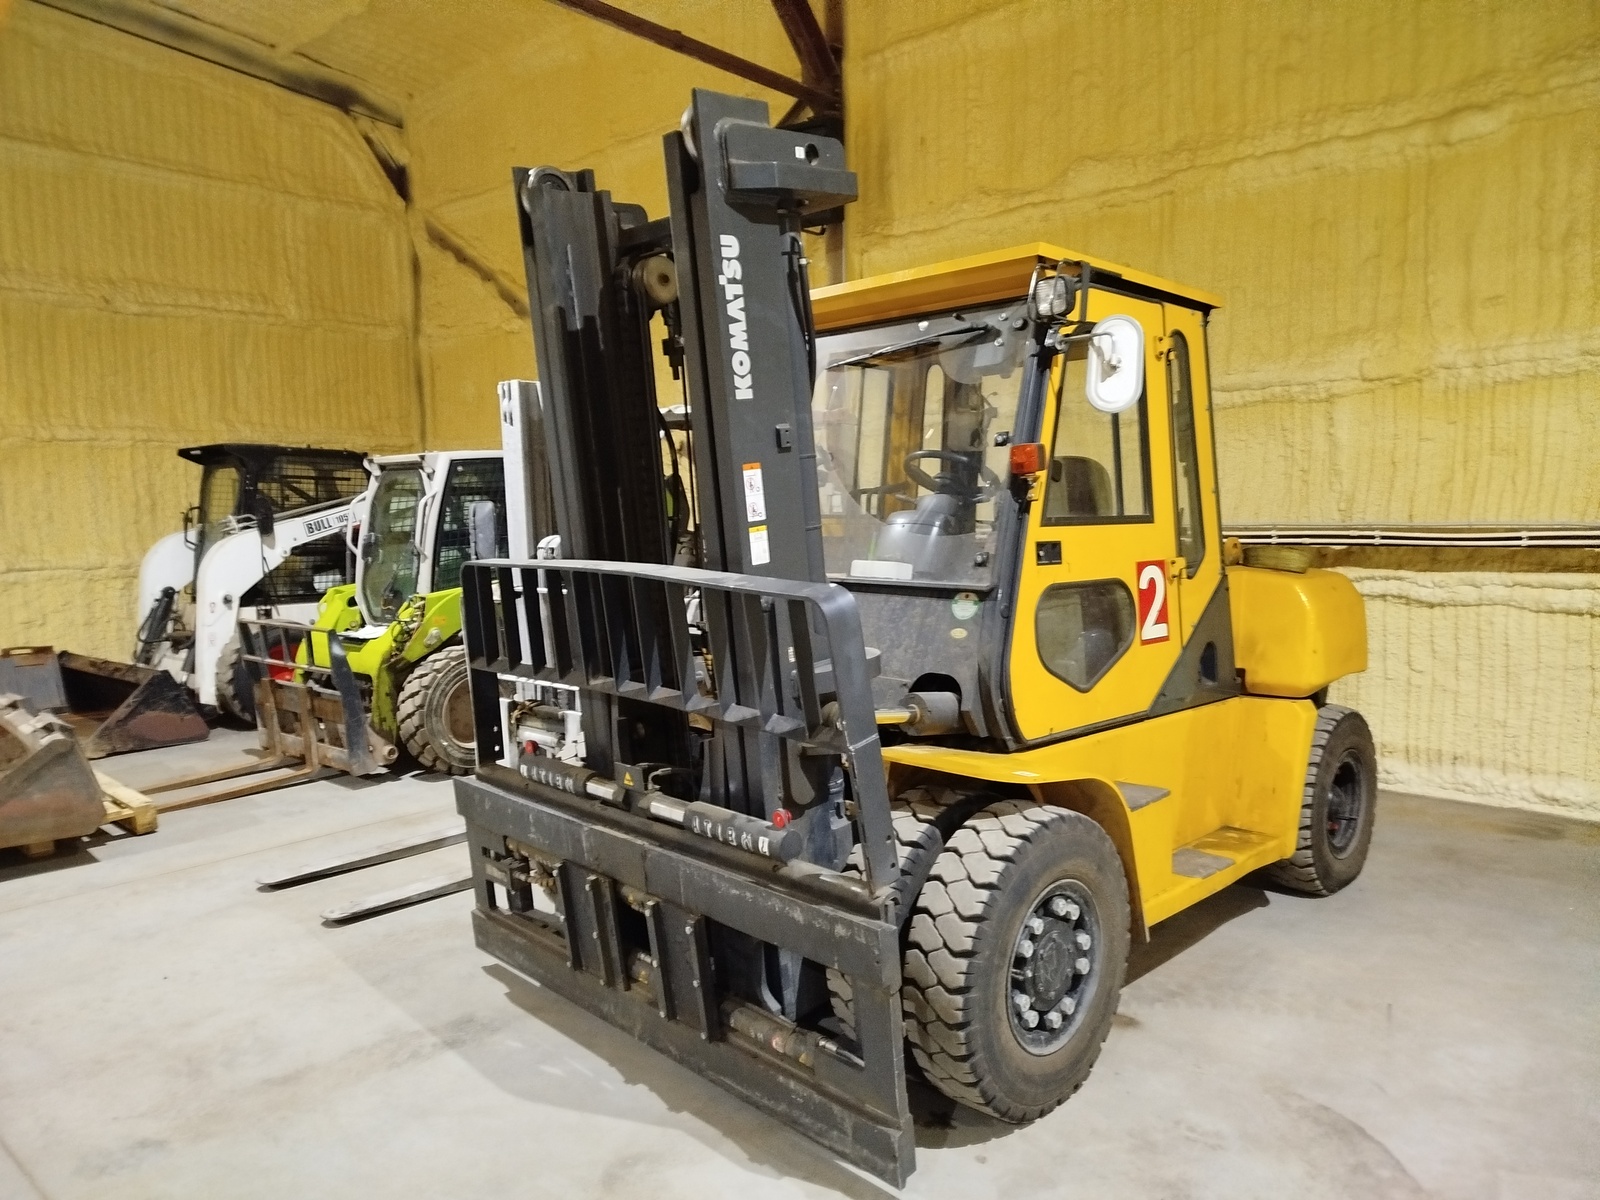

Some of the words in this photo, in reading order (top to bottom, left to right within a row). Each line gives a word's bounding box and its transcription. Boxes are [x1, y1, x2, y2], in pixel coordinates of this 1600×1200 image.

[718, 234, 754, 400] KOMATSU
[306, 517, 333, 534] BULL
[1139, 564, 1169, 641] 2
